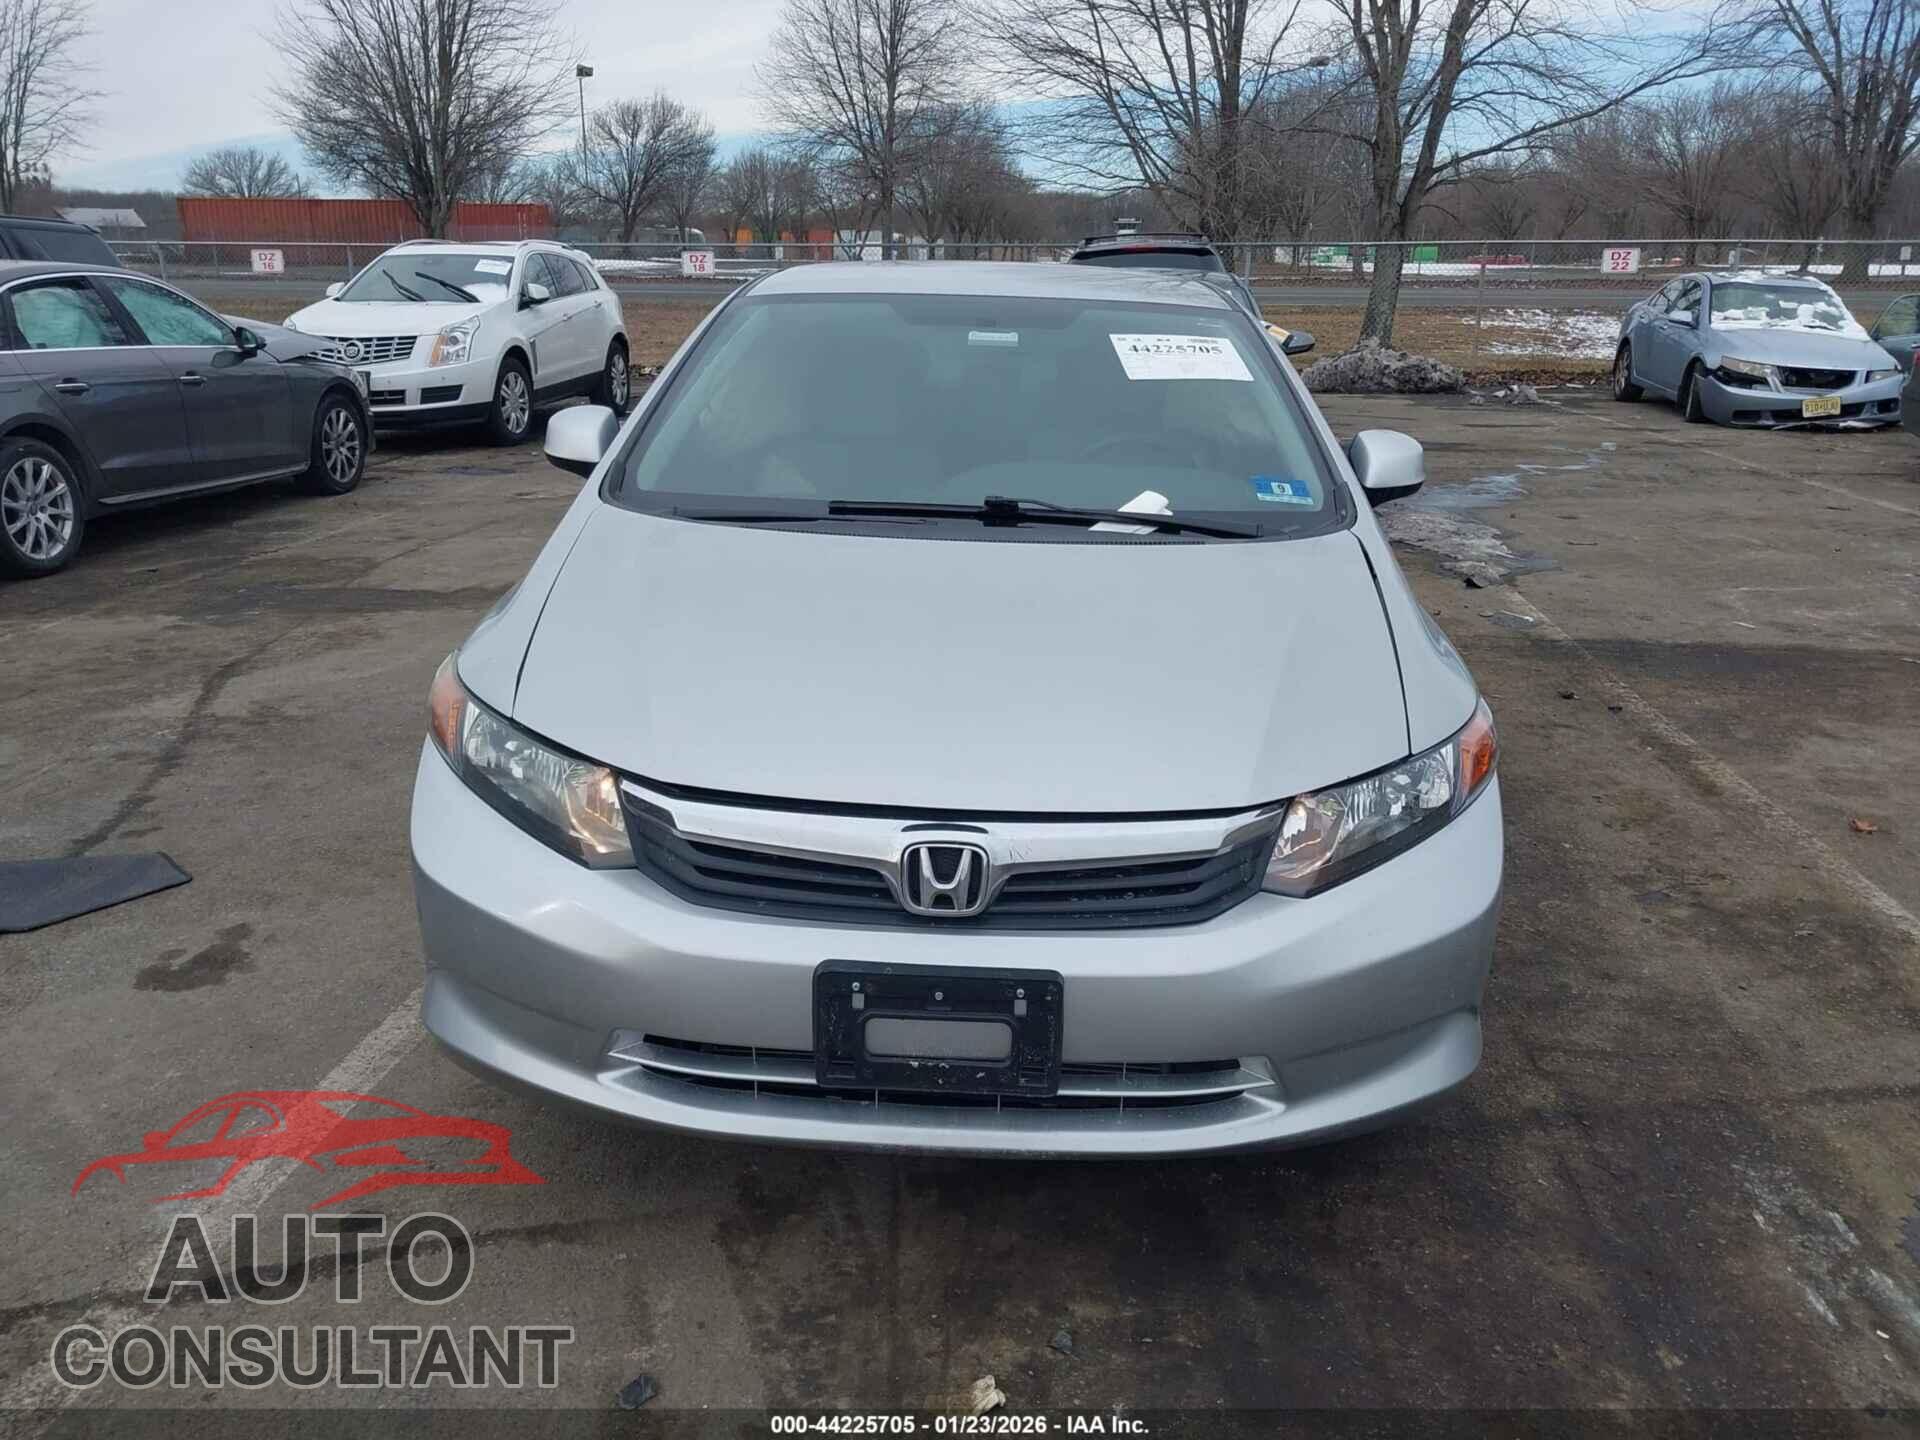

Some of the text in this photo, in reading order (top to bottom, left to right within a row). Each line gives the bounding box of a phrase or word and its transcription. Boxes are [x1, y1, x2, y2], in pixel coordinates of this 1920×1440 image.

[259, 253, 274, 261] DZ
[689, 255, 706, 263] DZ
[1611, 251, 1632, 260] DZ
[693, 264, 705, 272] 18
[1611, 261, 1629, 270] 22
[1128, 344, 1223, 354] 44225705
